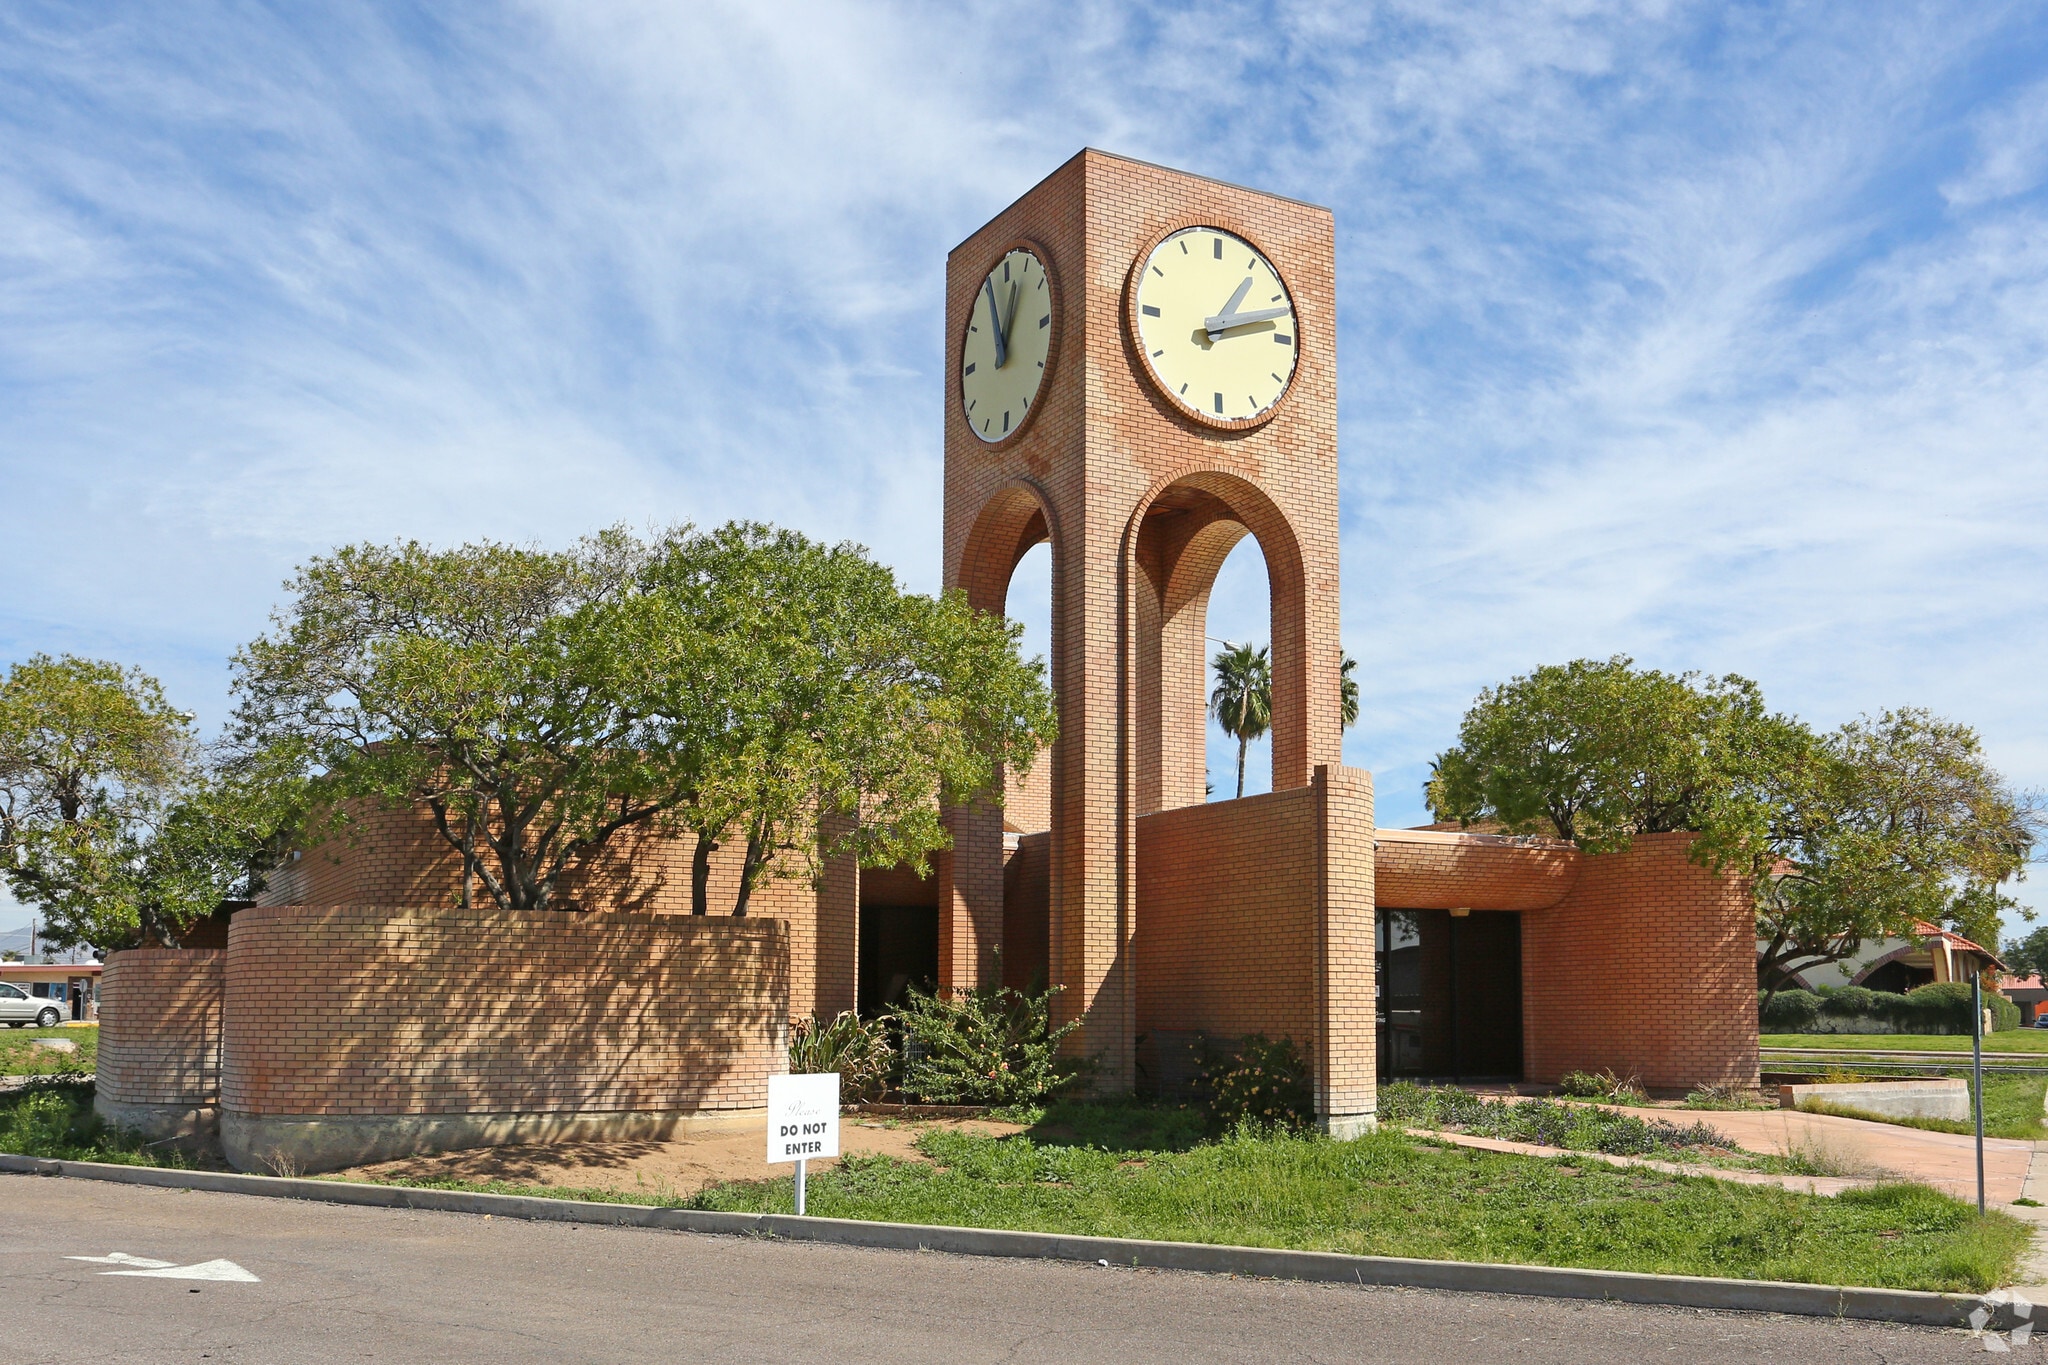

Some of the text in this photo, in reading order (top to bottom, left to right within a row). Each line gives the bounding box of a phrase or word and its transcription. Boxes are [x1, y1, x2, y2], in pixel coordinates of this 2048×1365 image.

[780, 1122, 827, 1137] DO NOT
[785, 1141, 821, 1155] ENTER
